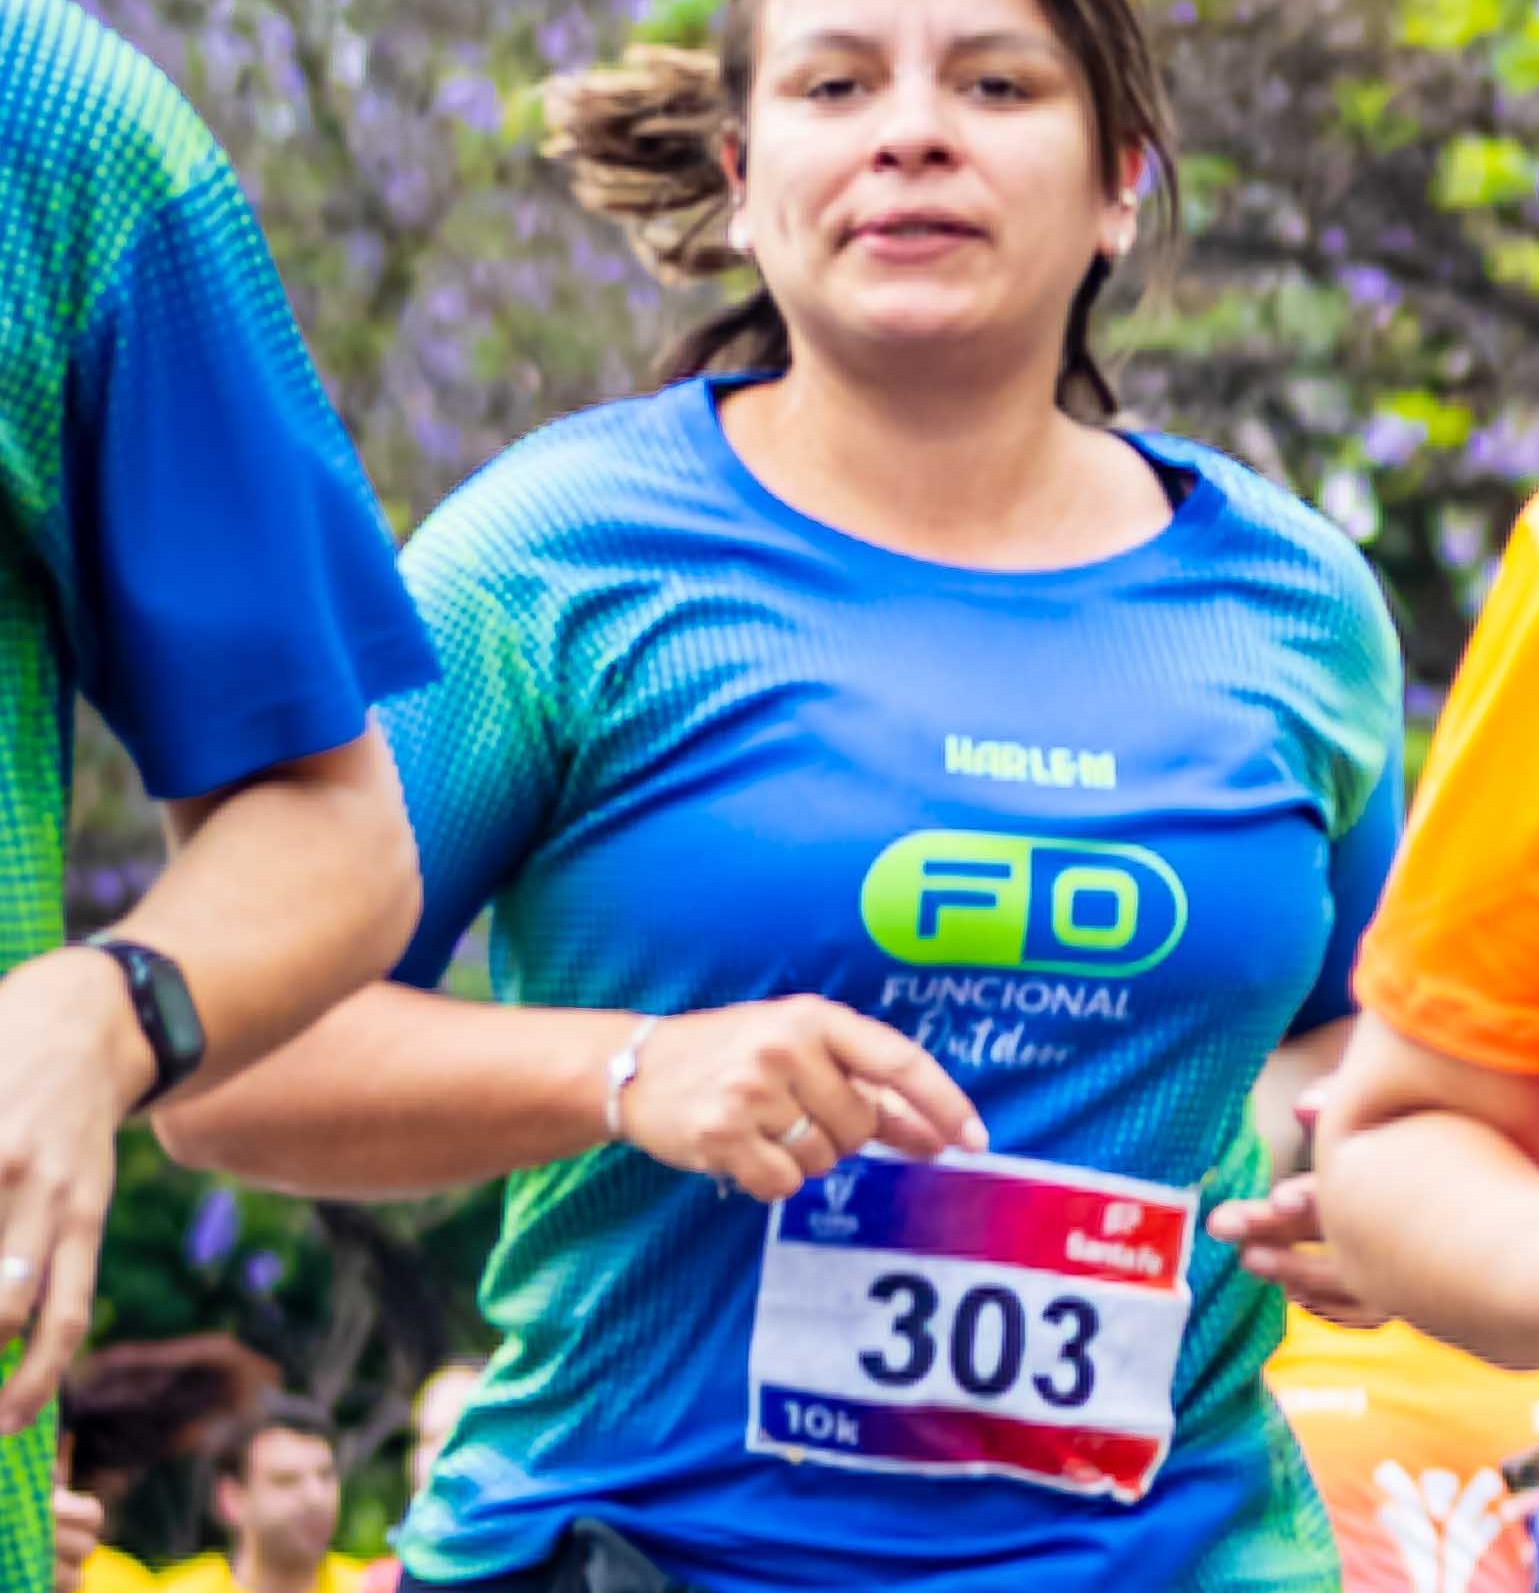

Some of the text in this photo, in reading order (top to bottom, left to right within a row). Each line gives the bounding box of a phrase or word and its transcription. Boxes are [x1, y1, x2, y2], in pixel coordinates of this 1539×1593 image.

[944, 733, 1117, 789] HARLEM
[880, 974, 1131, 1020] FUNCIONAL
[857, 1273, 1100, 1408] 303
